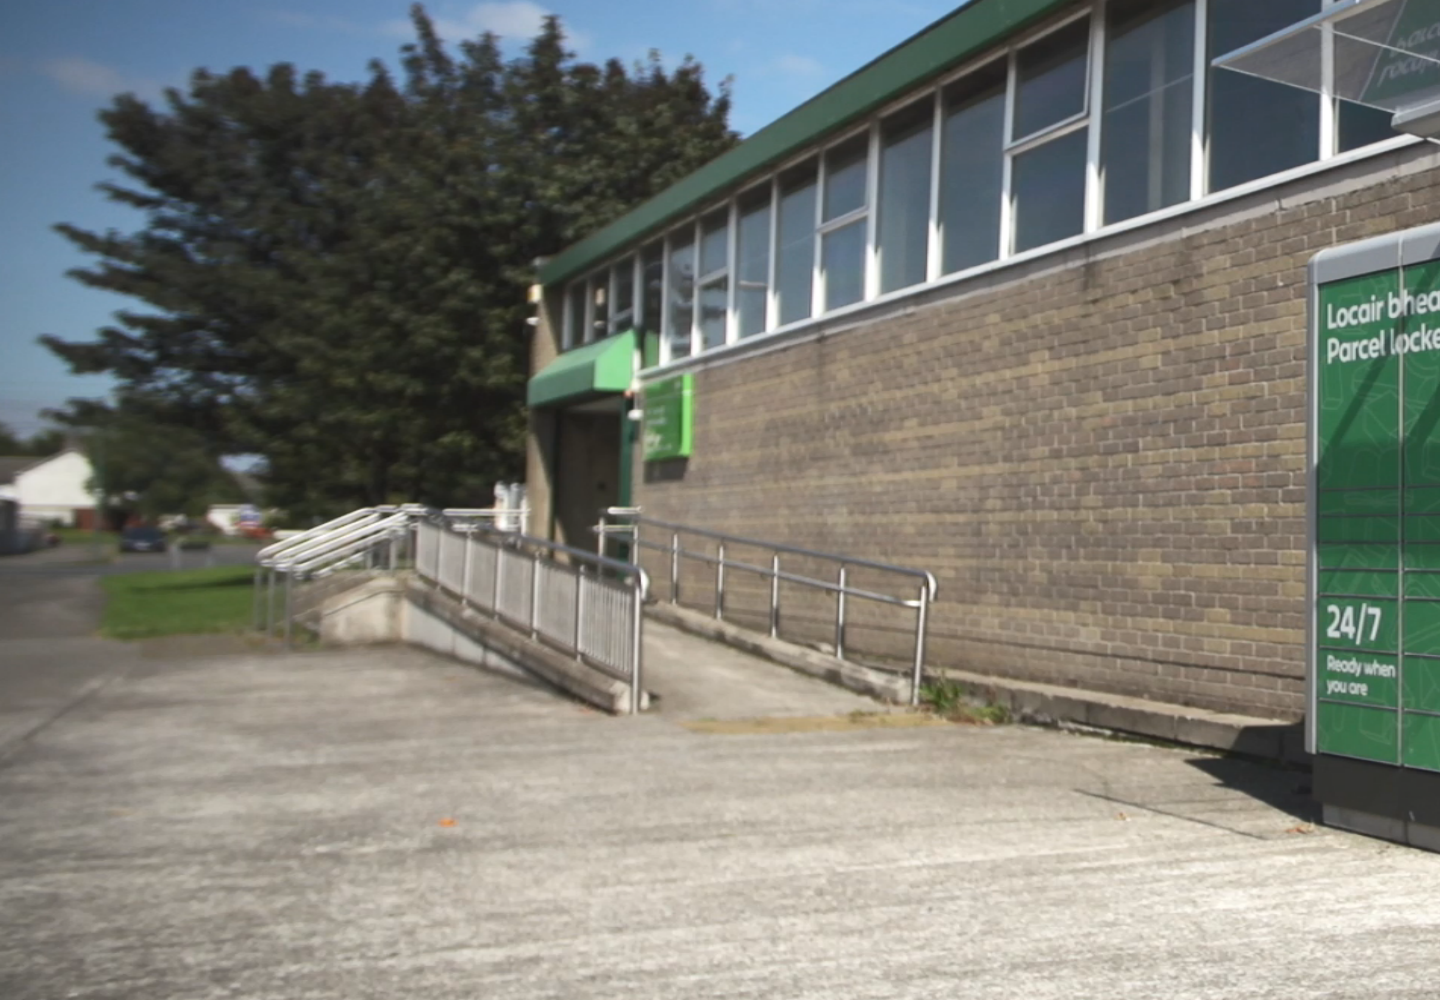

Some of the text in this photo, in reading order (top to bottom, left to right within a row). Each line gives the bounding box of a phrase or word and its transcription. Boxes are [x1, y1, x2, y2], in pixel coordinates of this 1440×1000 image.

[1327, 295, 1384, 329] Locair
[1327, 329, 1386, 364] Parcel
[1326, 602, 1382, 645] 24/7
[1327, 655, 1396, 678] Ready when
[1327, 680, 1368, 696] you are
